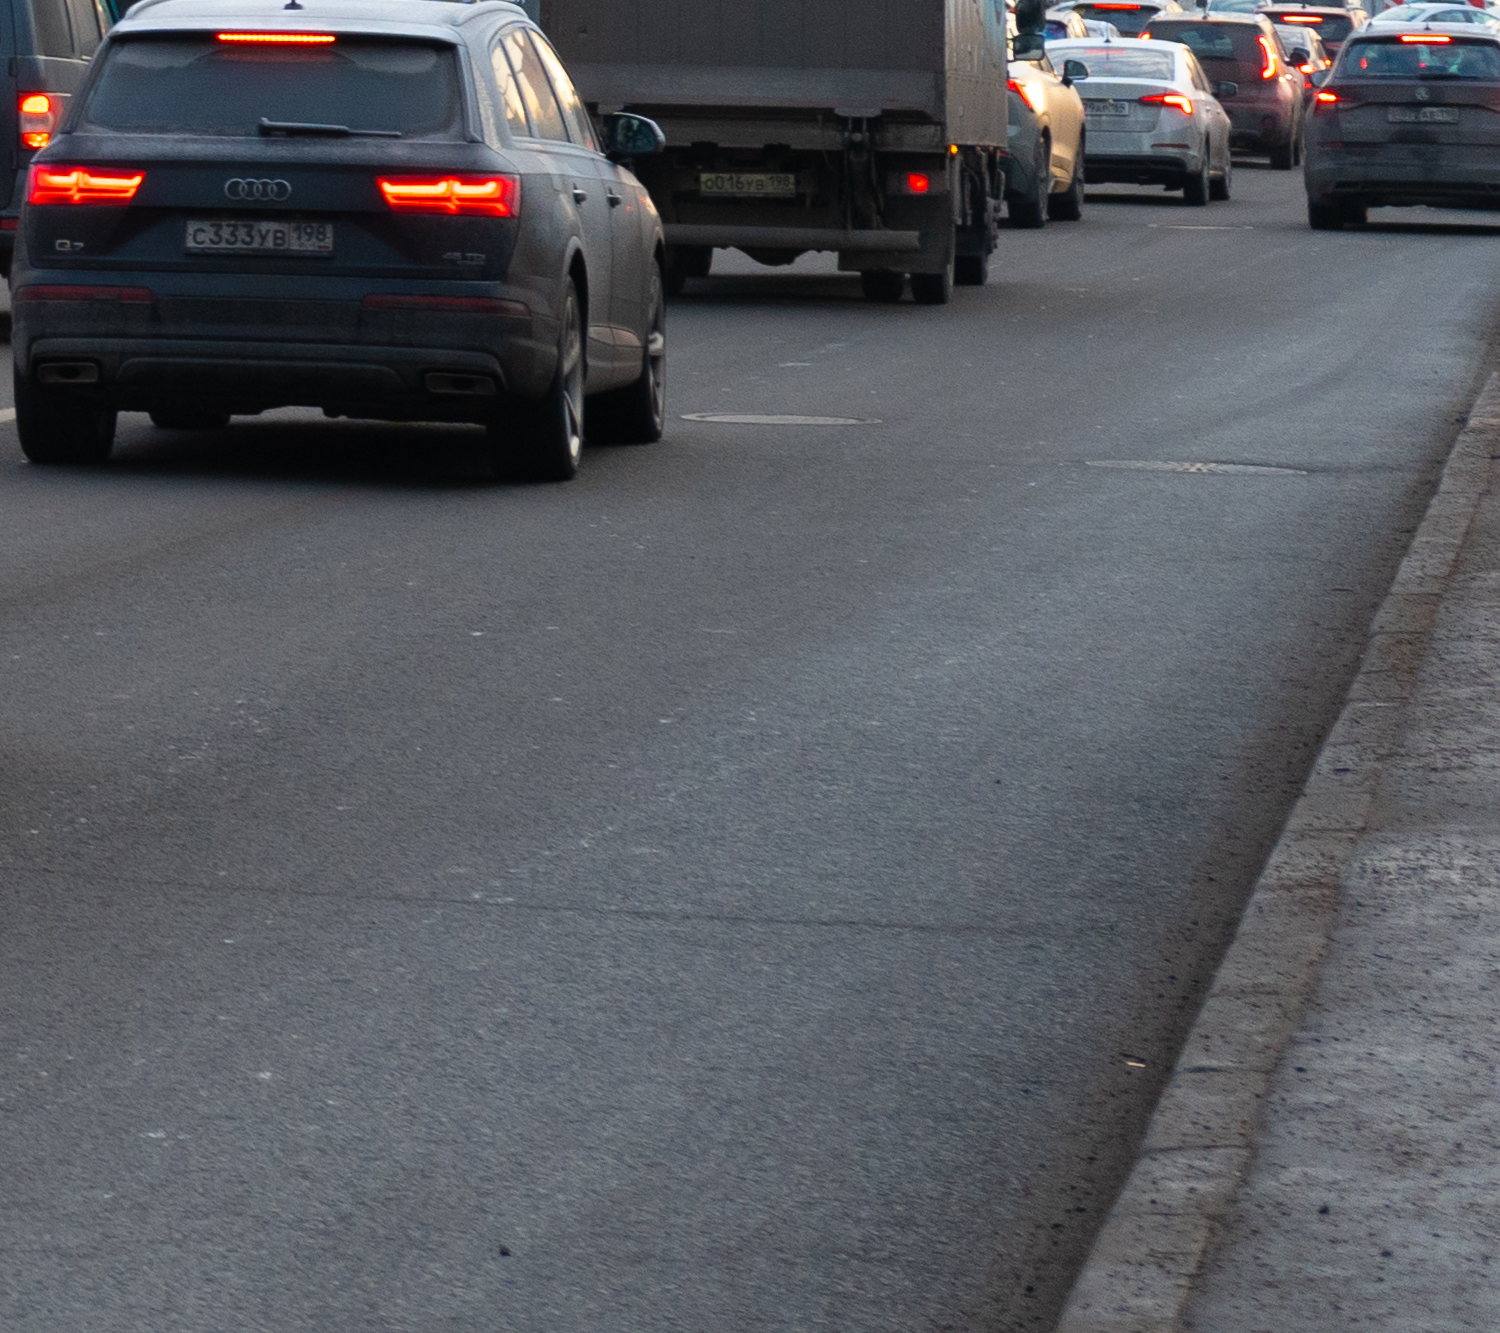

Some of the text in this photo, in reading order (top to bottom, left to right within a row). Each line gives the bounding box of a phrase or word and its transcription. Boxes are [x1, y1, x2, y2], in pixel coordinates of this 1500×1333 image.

[192, 223, 328, 247] С333УВ 198
[54, 238, 86, 252] Q7
